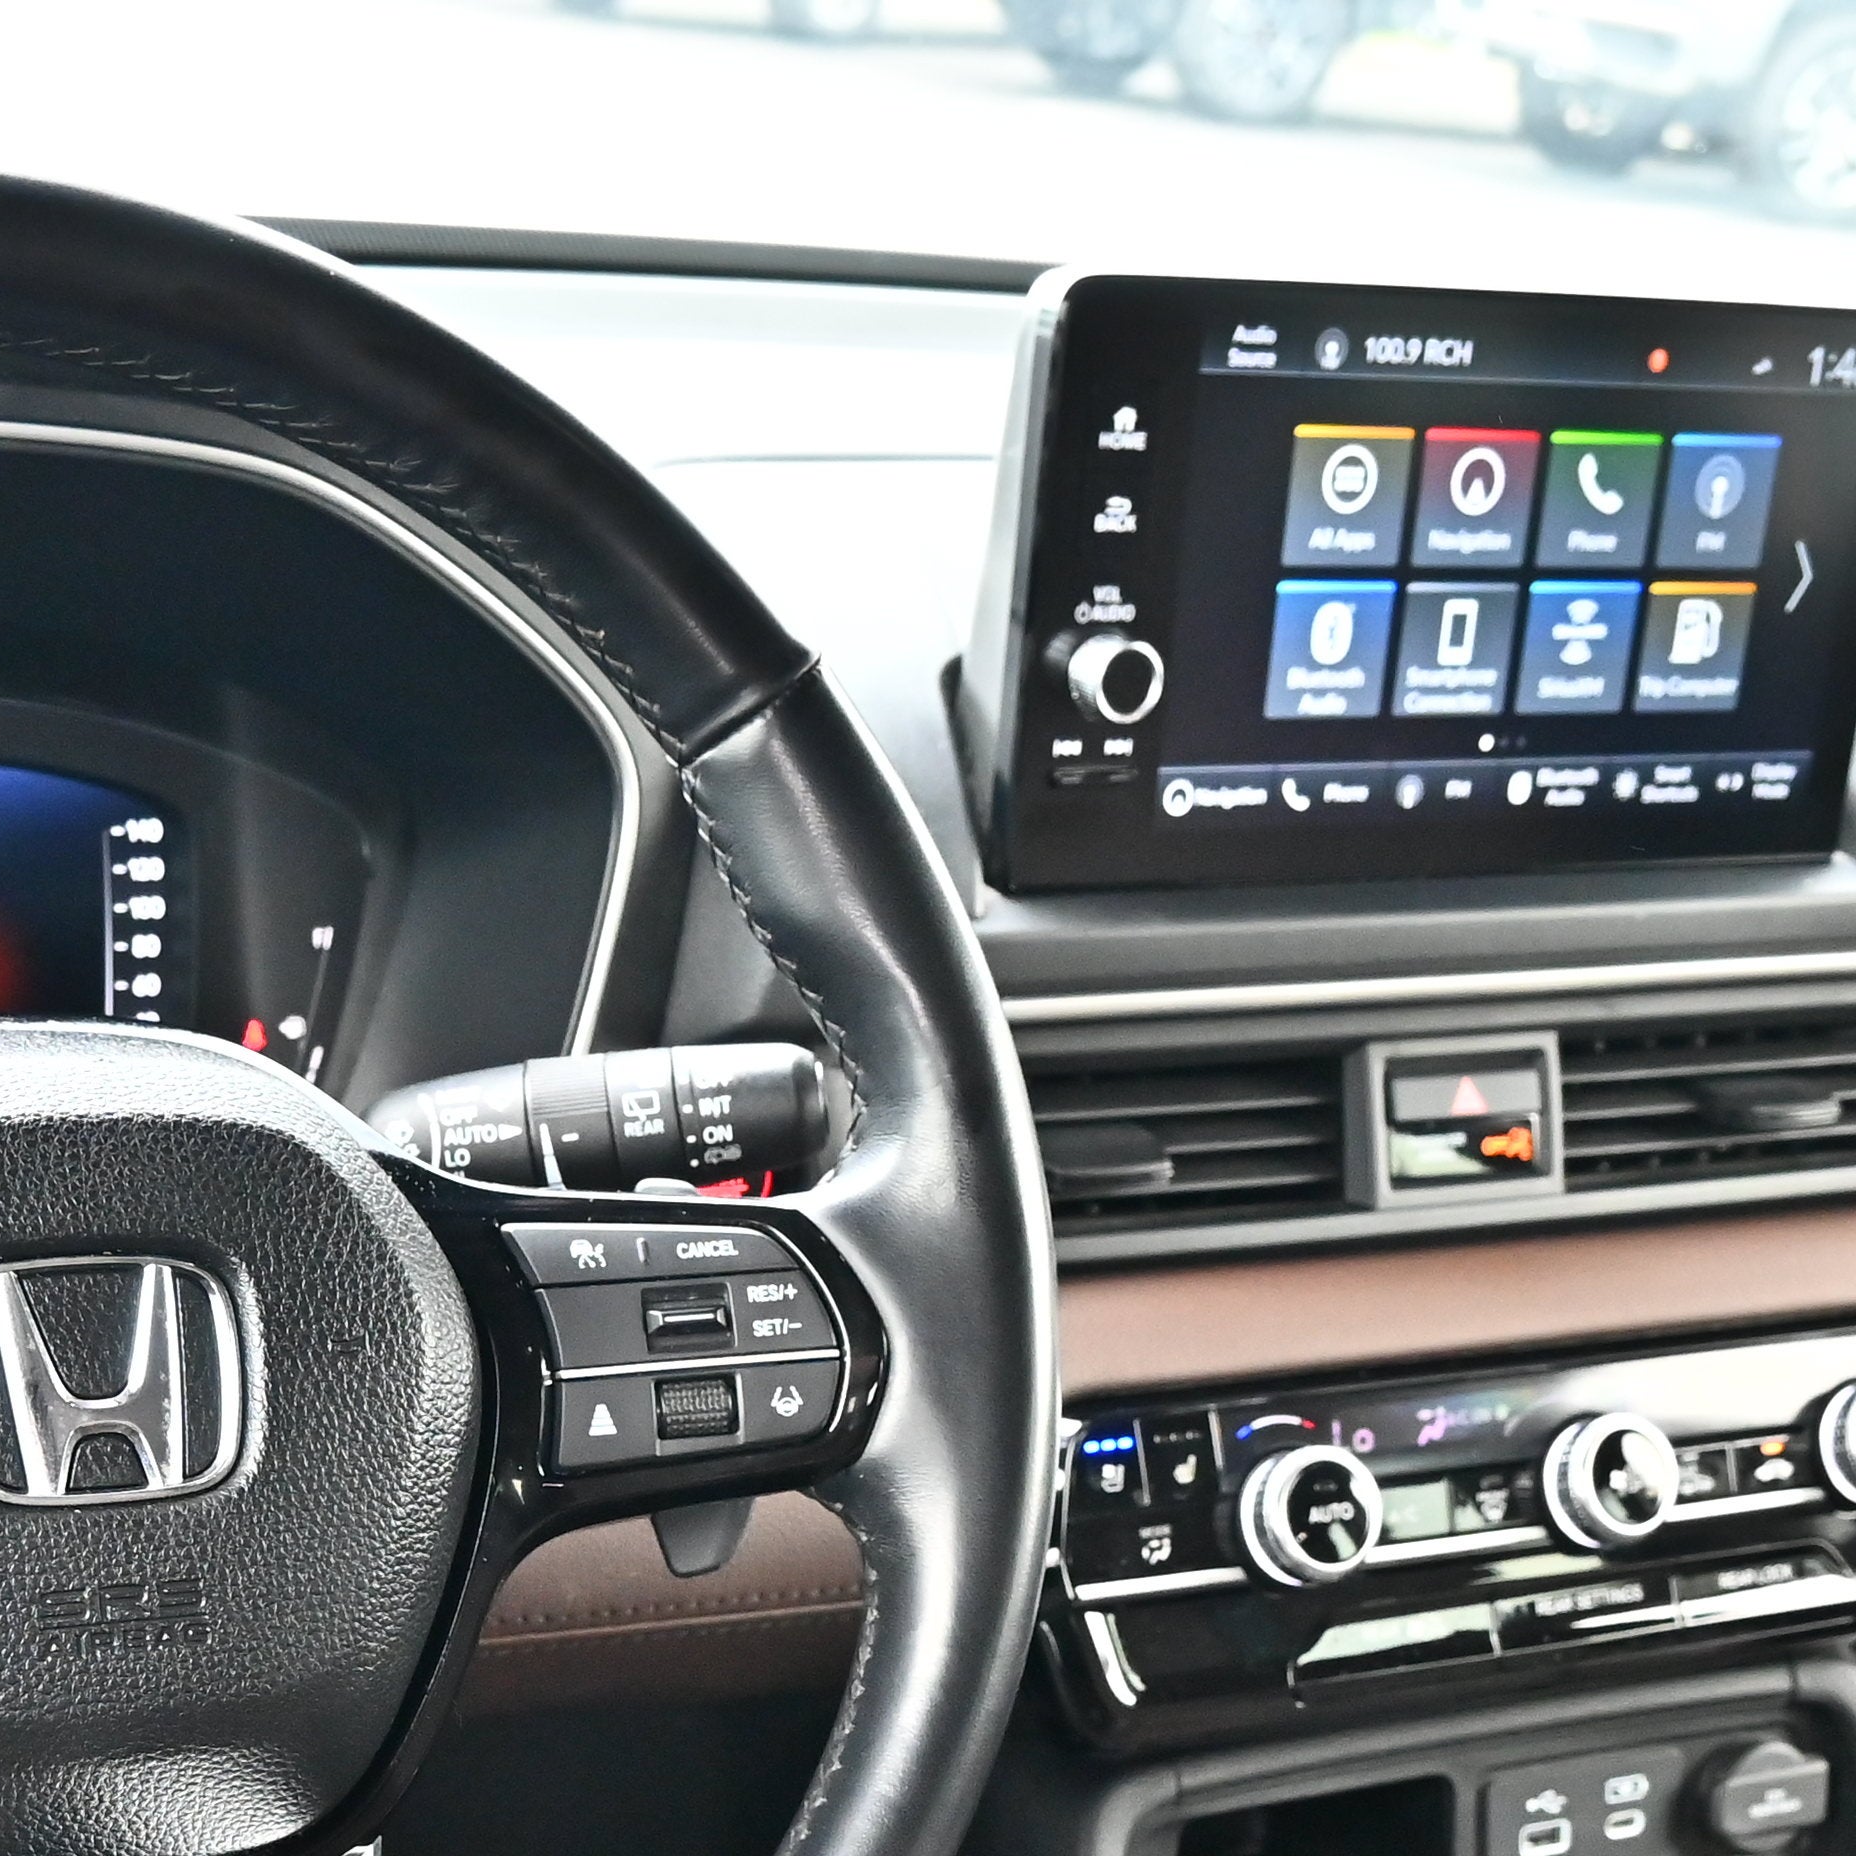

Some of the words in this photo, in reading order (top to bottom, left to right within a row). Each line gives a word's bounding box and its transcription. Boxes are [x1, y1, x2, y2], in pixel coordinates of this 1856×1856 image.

[1364, 336, 1423, 366] 100.9
[1423, 337, 1474, 367] RCH
[125, 817, 165, 844] 140
[126, 856, 166, 882] 120
[127, 895, 167, 921] 100
[697, 1094, 733, 1119] INT
[443, 1122, 499, 1147] AUTO
[623, 1118, 665, 1138] REAR
[702, 1123, 734, 1145] ON
[443, 1147, 472, 1168] LO
[675, 1239, 740, 1260] CANCEL
[746, 1282, 799, 1303] RES/+
[751, 1317, 803, 1338] SET/-
[1308, 1500, 1356, 1526] AUTO
[39, 1577, 211, 1631] SRS
[39, 1622, 214, 1660] AIRBAG
